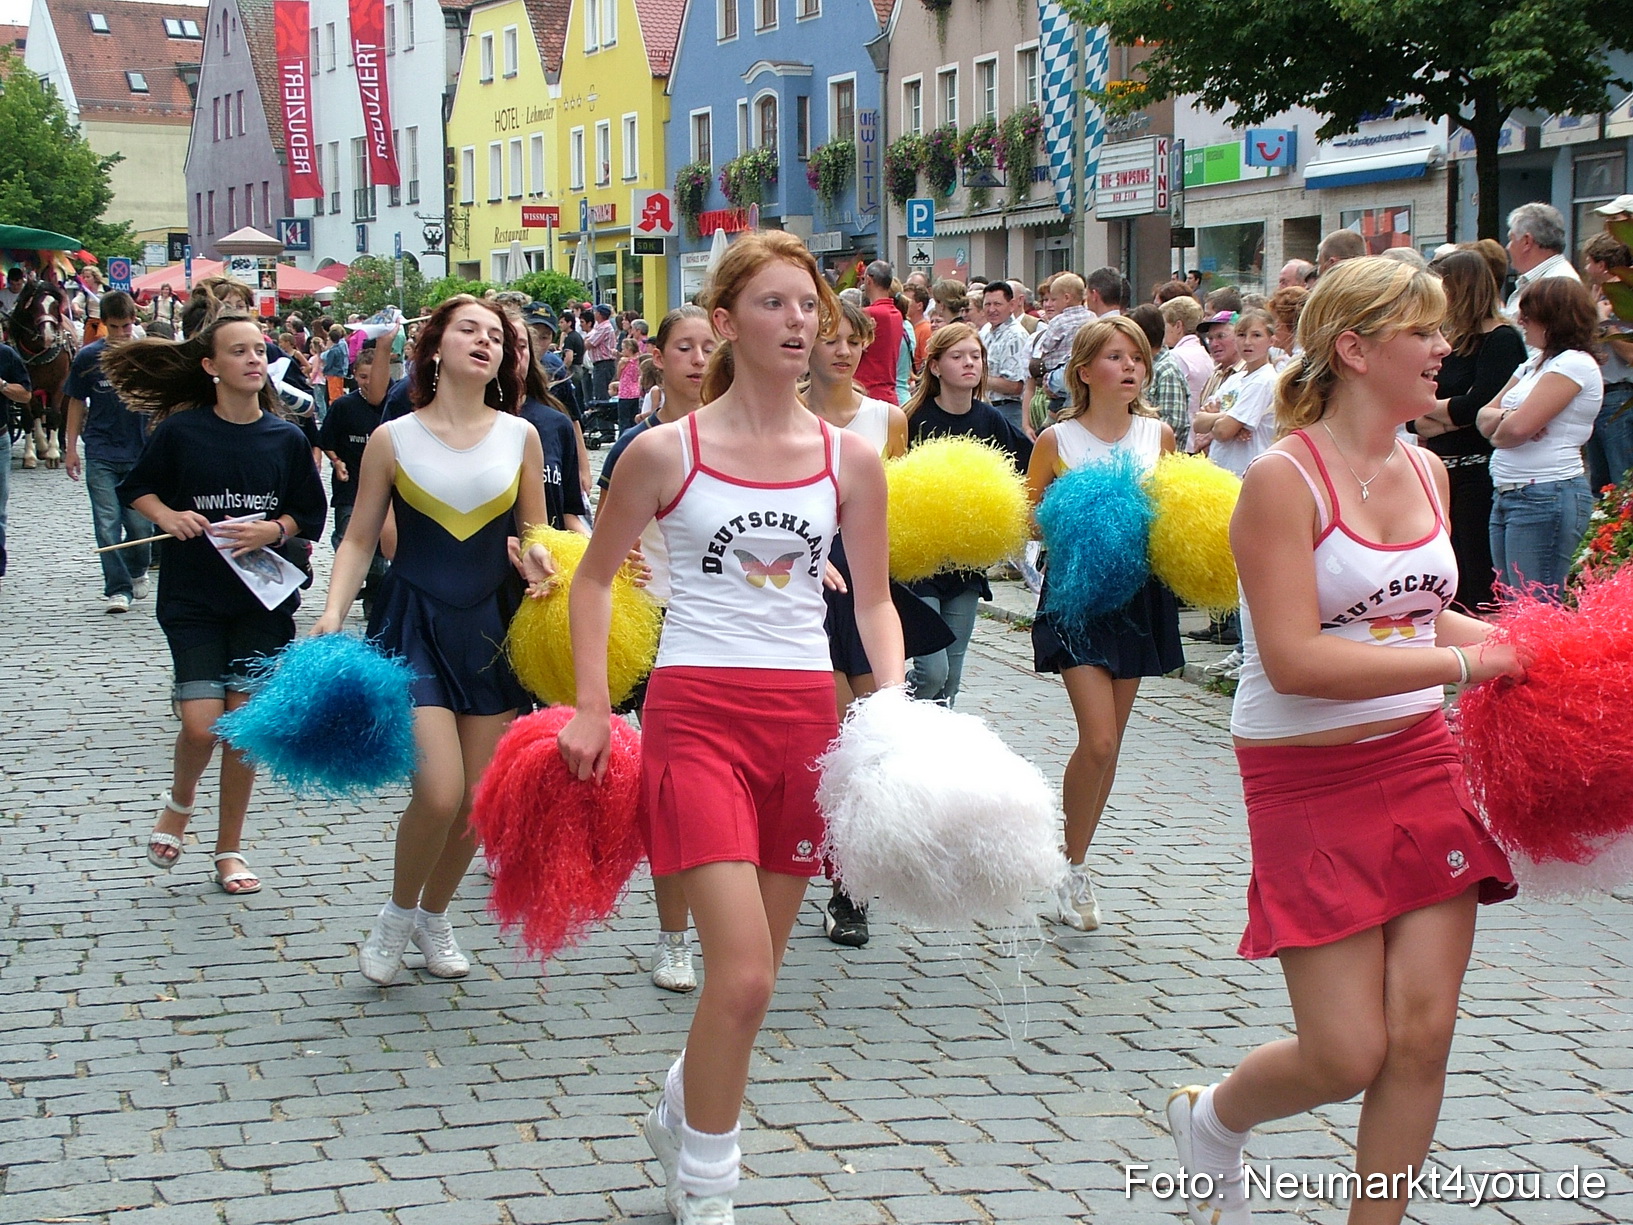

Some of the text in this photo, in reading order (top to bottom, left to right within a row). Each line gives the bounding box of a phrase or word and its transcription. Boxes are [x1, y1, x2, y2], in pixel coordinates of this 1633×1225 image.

[495, 103, 555, 132] HOTEL Lehmeier
[1101, 168, 1150, 188] DIE SIMPSONS
[1157, 140, 1168, 209] KINO
[913, 204, 929, 233] P
[494, 226, 529, 244] Restaurant
[111, 282, 130, 292] TAXI
